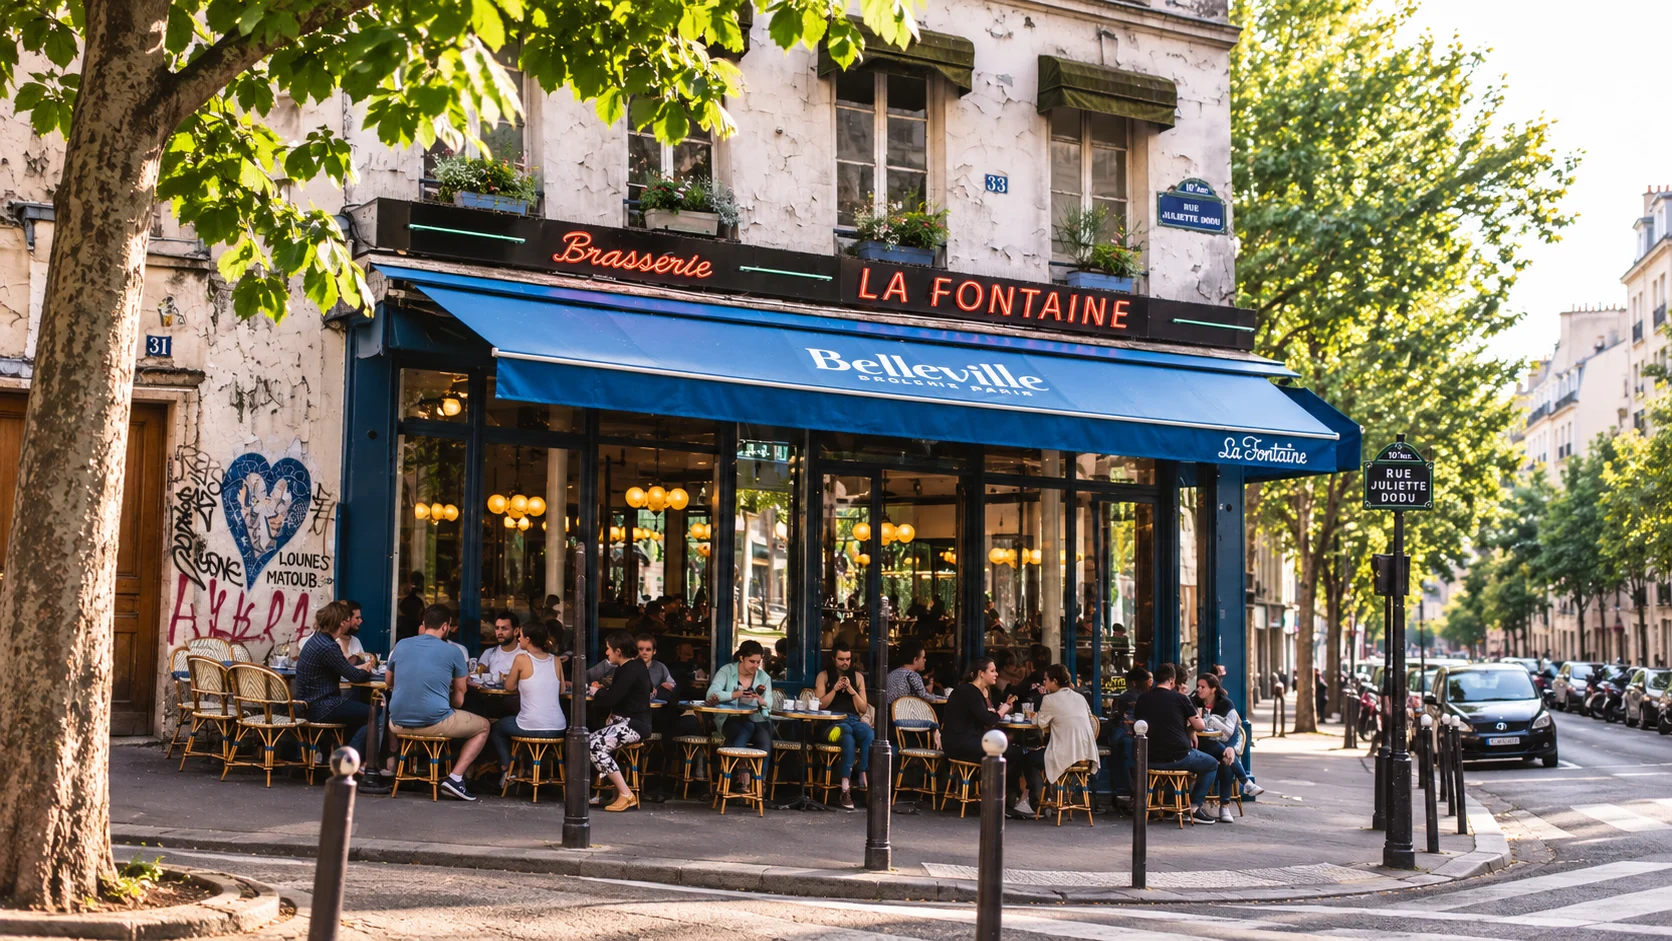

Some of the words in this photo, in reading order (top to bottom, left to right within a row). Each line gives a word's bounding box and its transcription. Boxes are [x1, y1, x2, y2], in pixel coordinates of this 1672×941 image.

[987, 175, 1005, 192] 33
[1183, 203, 1199, 212] RUE
[1200, 216, 1221, 226] DODU
[858, 267, 908, 303] LA
[930, 277, 1131, 329] FONTAINE
[149, 337, 168, 355] 31
[805, 347, 1050, 391] Belleville
[1218, 437, 1242, 460] La
[1242, 435, 1308, 465] Fontaine
[1386, 468, 1412, 479] RUE
[1370, 480, 1427, 491] JULIETTE
[1381, 492, 1416, 503] DODU
[279, 551, 331, 571] LOUNES
